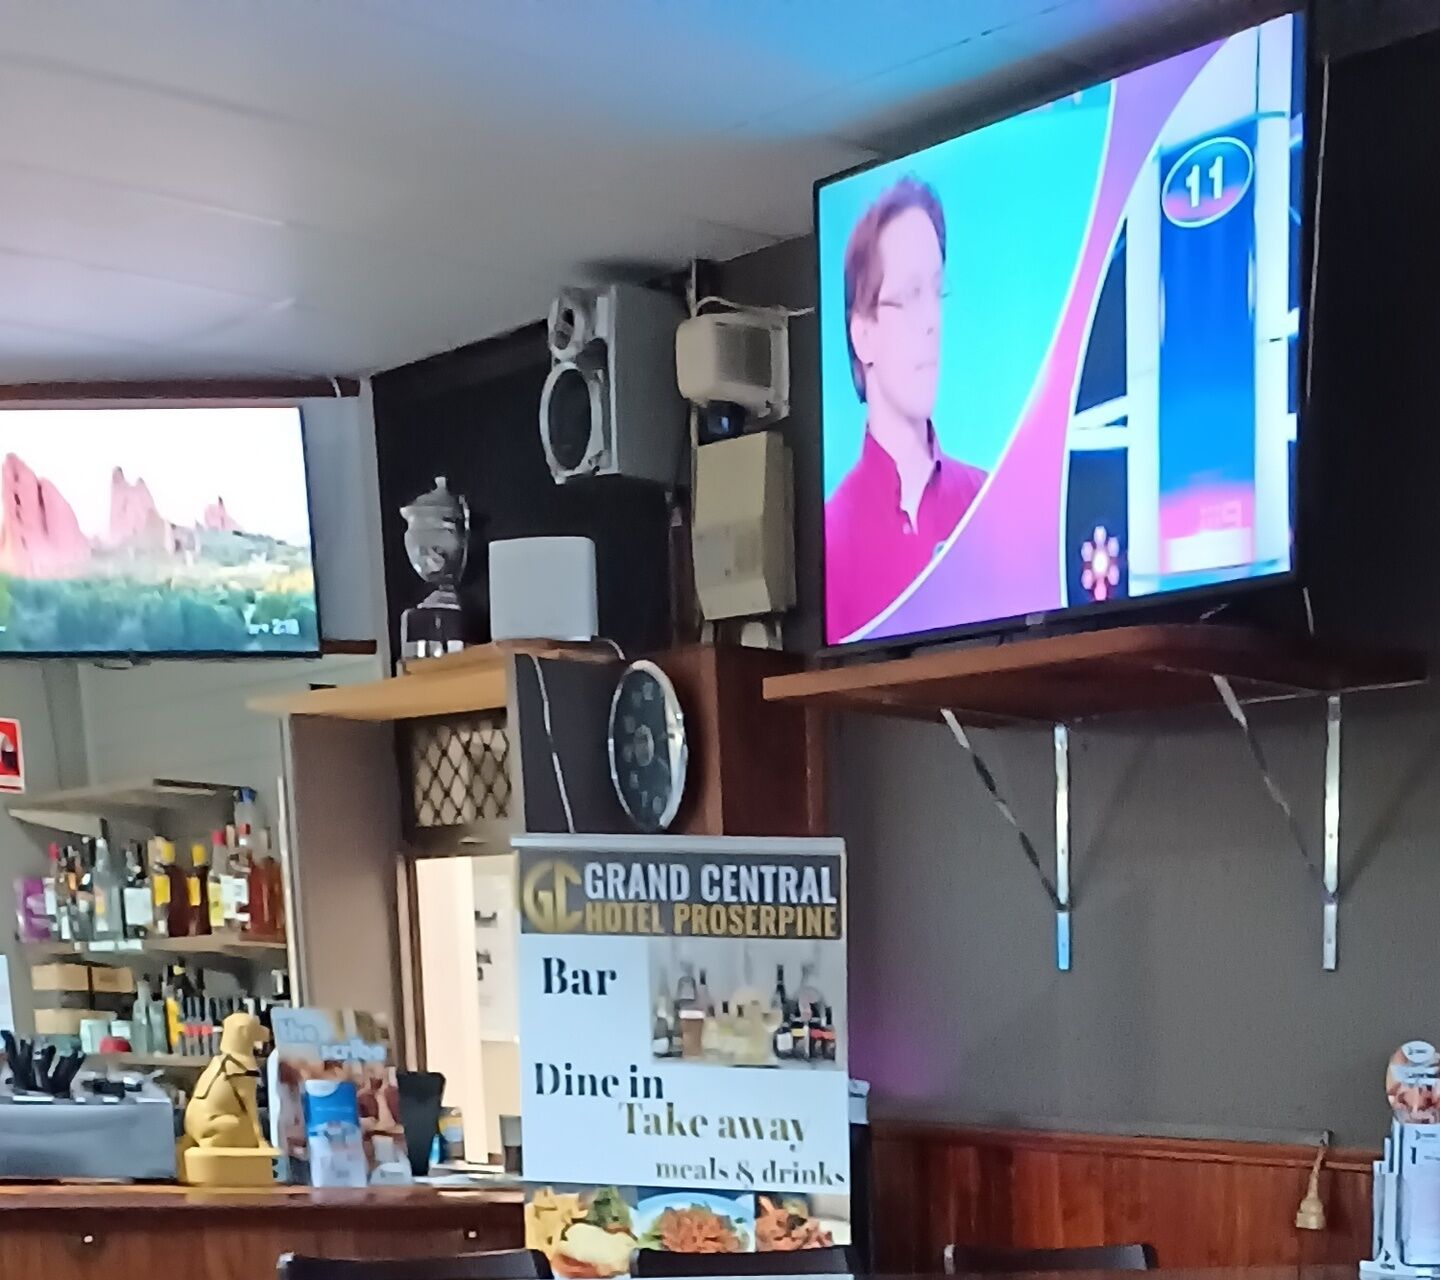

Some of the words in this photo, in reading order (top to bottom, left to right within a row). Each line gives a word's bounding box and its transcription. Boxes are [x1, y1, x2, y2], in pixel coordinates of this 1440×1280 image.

[1185, 156, 1224, 208] 11
[584, 861, 690, 902] GRAND
[701, 864, 837, 904] CENTRAL
[585, 902, 665, 934] HOTEL
[673, 904, 837, 938] PROSERPINE
[542, 957, 617, 997] Bar
[535, 1063, 620, 1097] Dine
[630, 1064, 664, 1099] in
[620, 1102, 708, 1138] Take
[718, 1114, 809, 1152] away
[656, 1157, 729, 1181] meals
[736, 1161, 754, 1187] &
[762, 1157, 845, 1187] drinks
